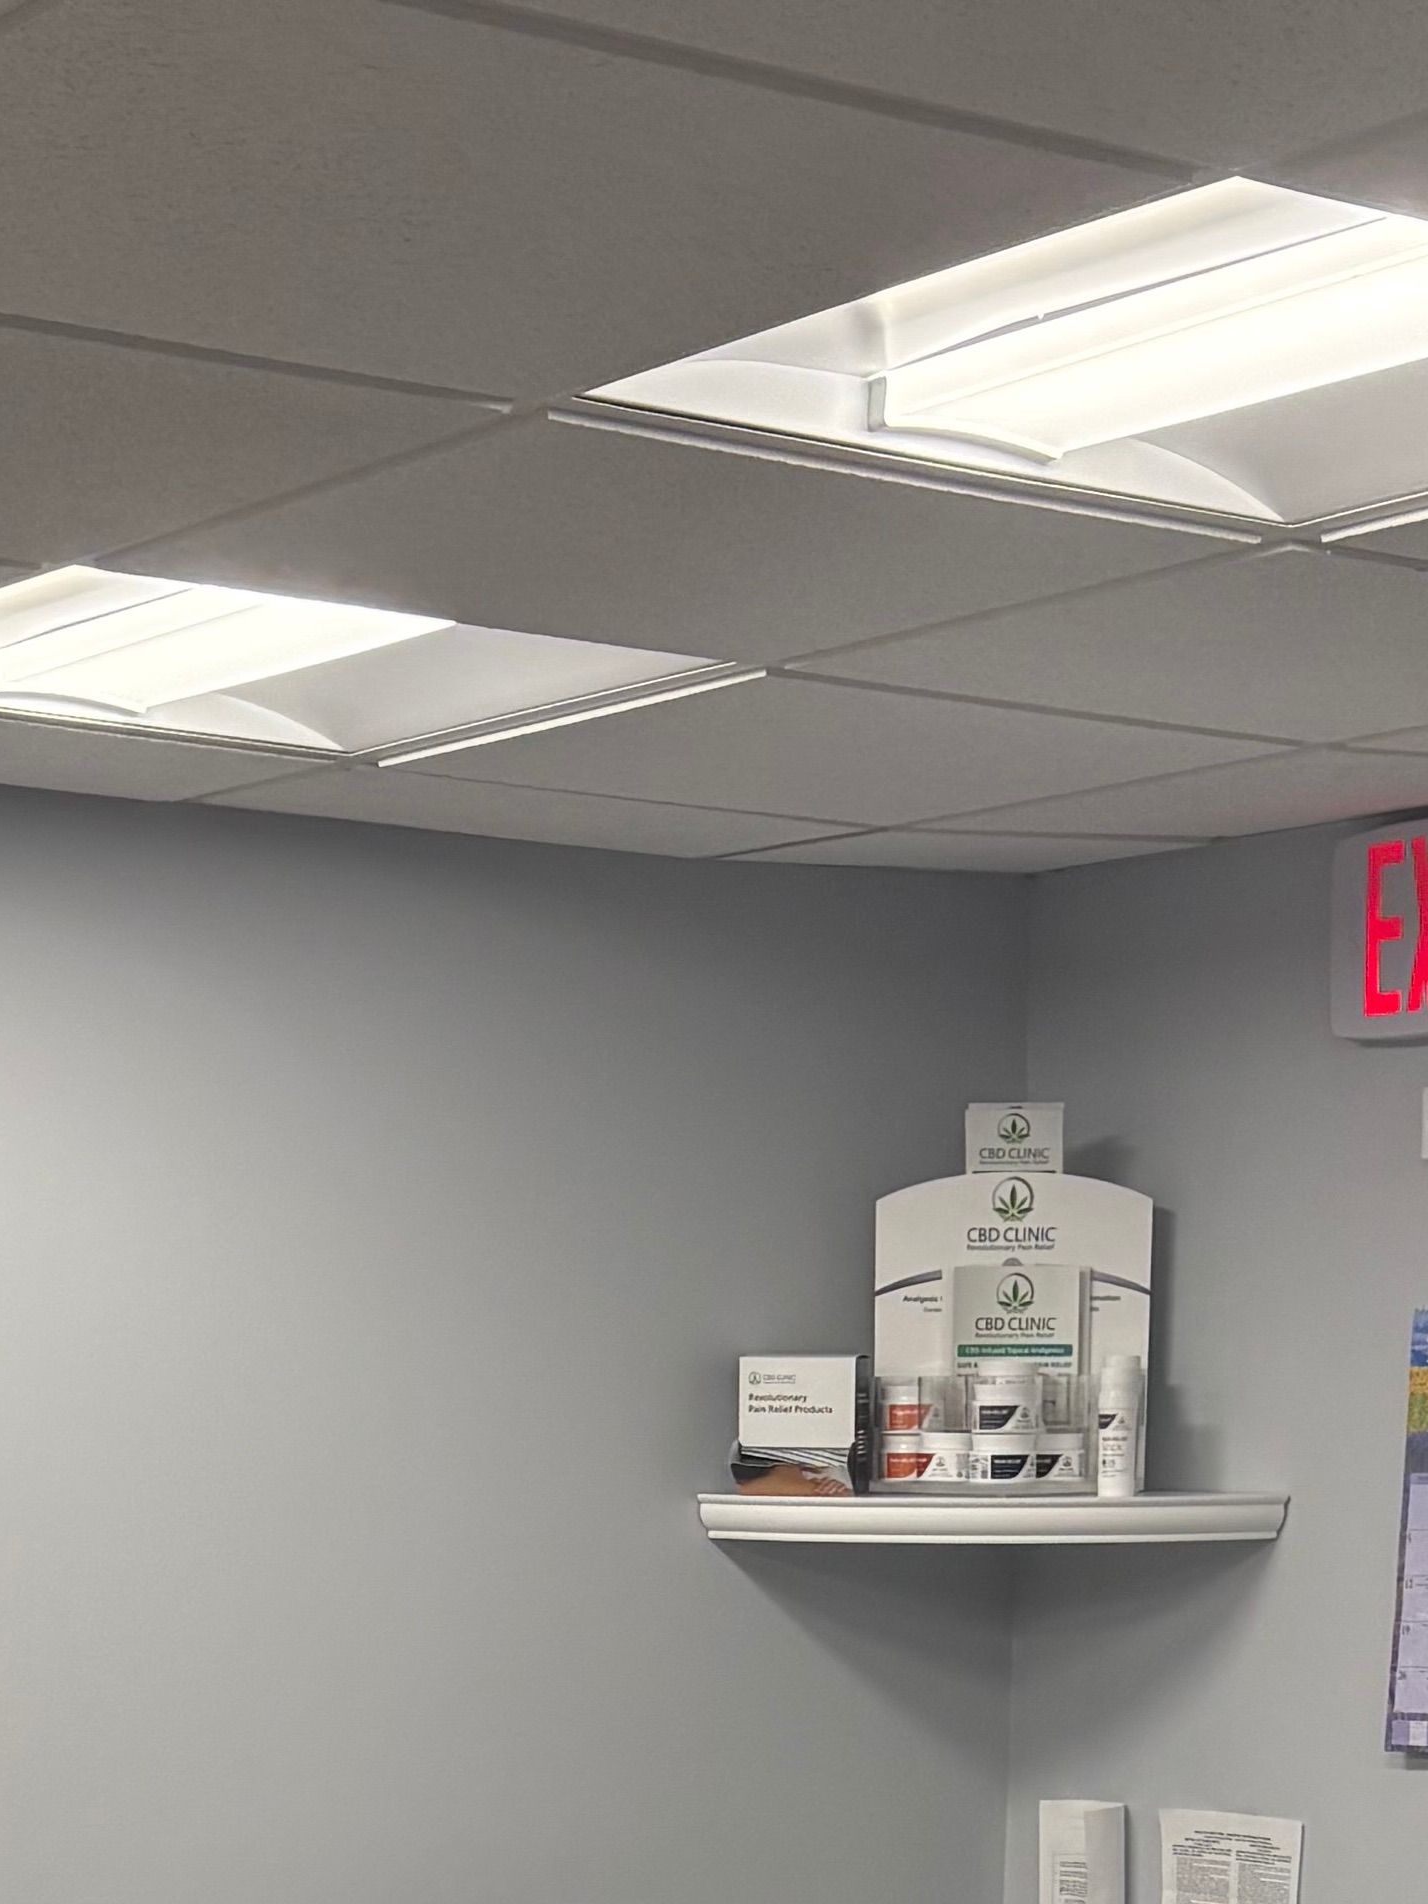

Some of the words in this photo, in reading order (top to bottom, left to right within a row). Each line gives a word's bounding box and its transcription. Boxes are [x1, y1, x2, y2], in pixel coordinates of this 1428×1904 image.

[979, 1147, 1006, 1160] CBD
[1008, 1147, 1051, 1160] CLINIC
[967, 1227, 1000, 1243] CBD
[1003, 1226, 1058, 1243] CLINIC
[975, 1317, 1005, 1331] CBD
[1008, 1317, 1057, 1331] CLINIC
[748, 1405, 766, 1413] Pain
[768, 1405, 793, 1413] Relief
[794, 1405, 833, 1414] Products
